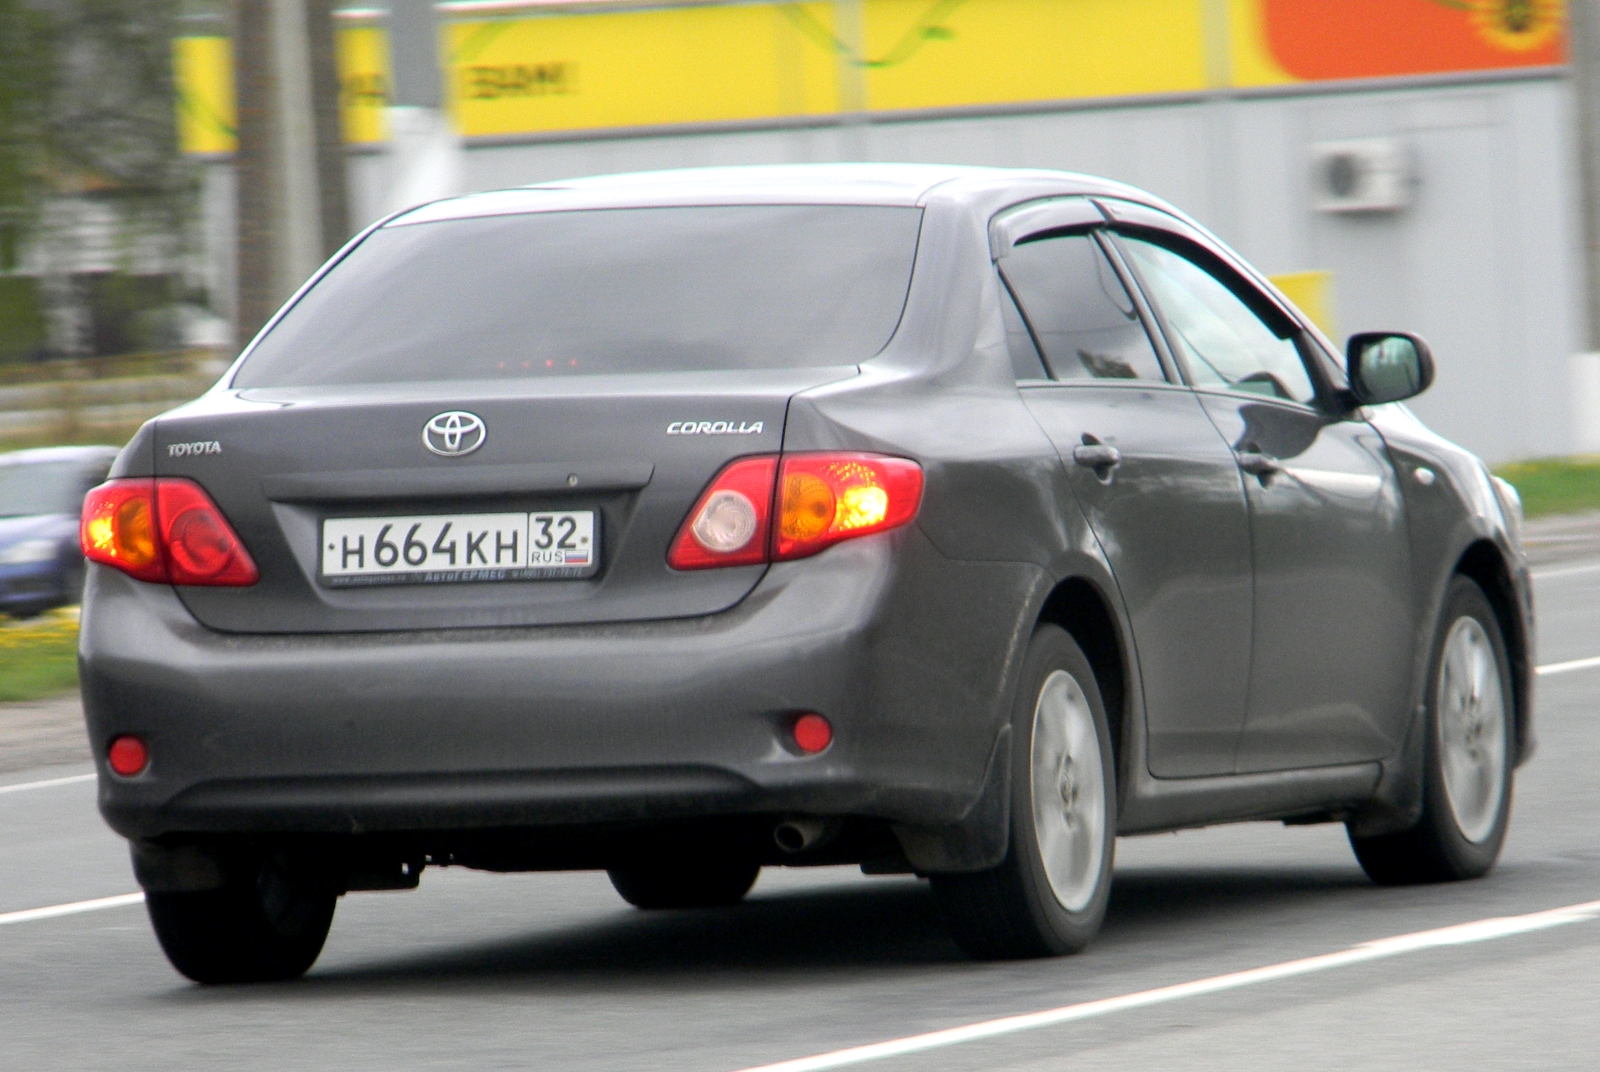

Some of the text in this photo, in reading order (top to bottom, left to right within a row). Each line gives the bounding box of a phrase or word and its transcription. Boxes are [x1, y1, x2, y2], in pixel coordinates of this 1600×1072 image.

[666, 421, 764, 434] COROLLA
[167, 441, 222, 457] TOYOTA
[534, 515, 577, 549] 32
[531, 551, 563, 563] RUS
